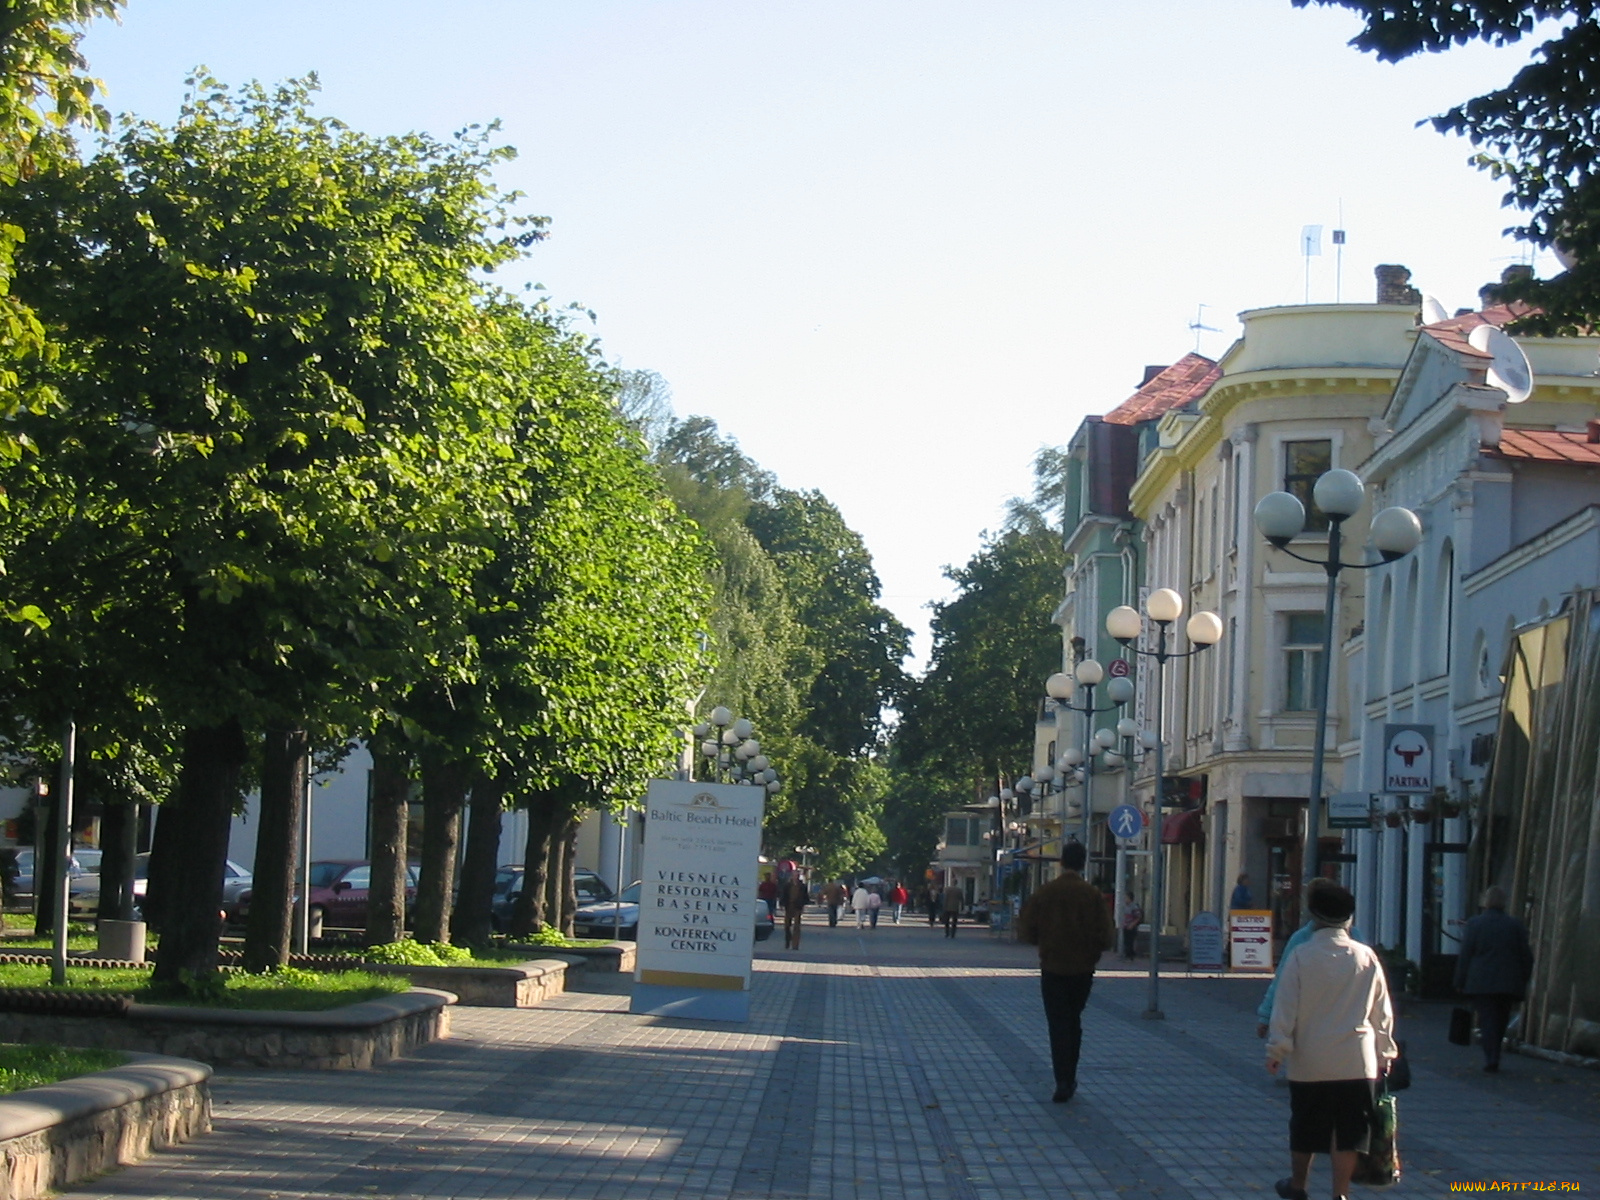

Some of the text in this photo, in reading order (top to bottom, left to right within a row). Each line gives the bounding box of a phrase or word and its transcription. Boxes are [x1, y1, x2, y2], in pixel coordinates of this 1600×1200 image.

[651, 810, 757, 827] Baltic Beach Hotel
[658, 870, 740, 886] VIESNĪCA
[658, 884, 739, 900] RESTORĀNS
[657, 898, 738, 913] BASEINS
[683, 913, 710, 924] SPA
[671, 939, 717, 952] CENTRS
